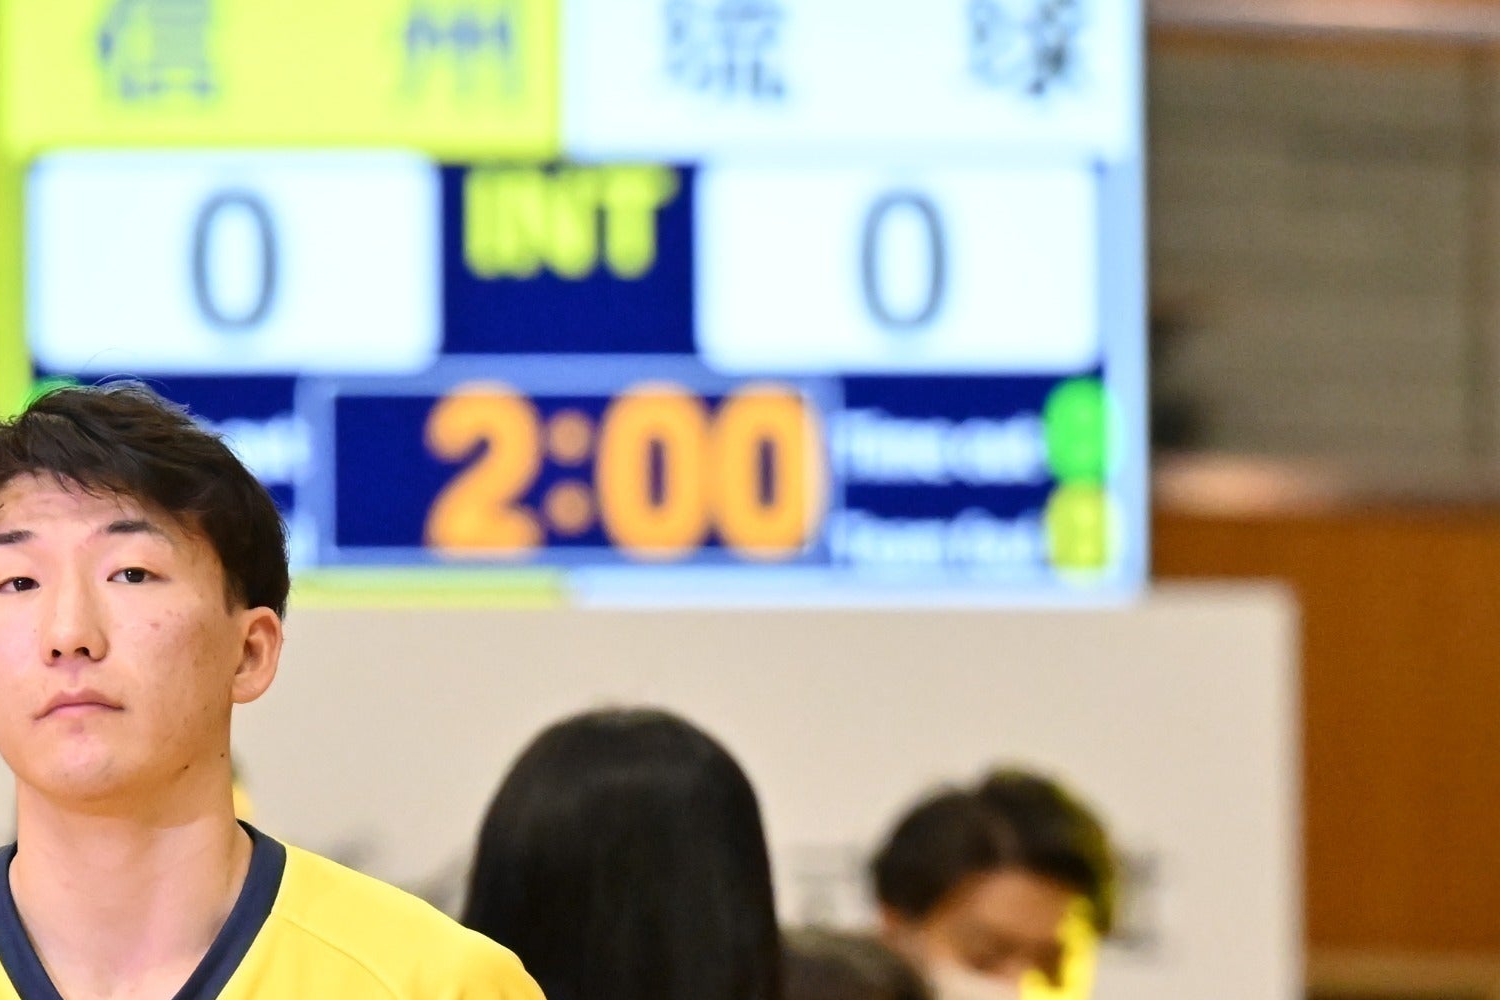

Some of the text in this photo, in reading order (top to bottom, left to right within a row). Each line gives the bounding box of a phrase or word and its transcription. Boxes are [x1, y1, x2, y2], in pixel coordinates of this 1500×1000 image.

[190, 188, 280, 332] 0
[463, 162, 680, 280] INT
[860, 188, 948, 332] 0
[424, 382, 828, 565] 2:00
